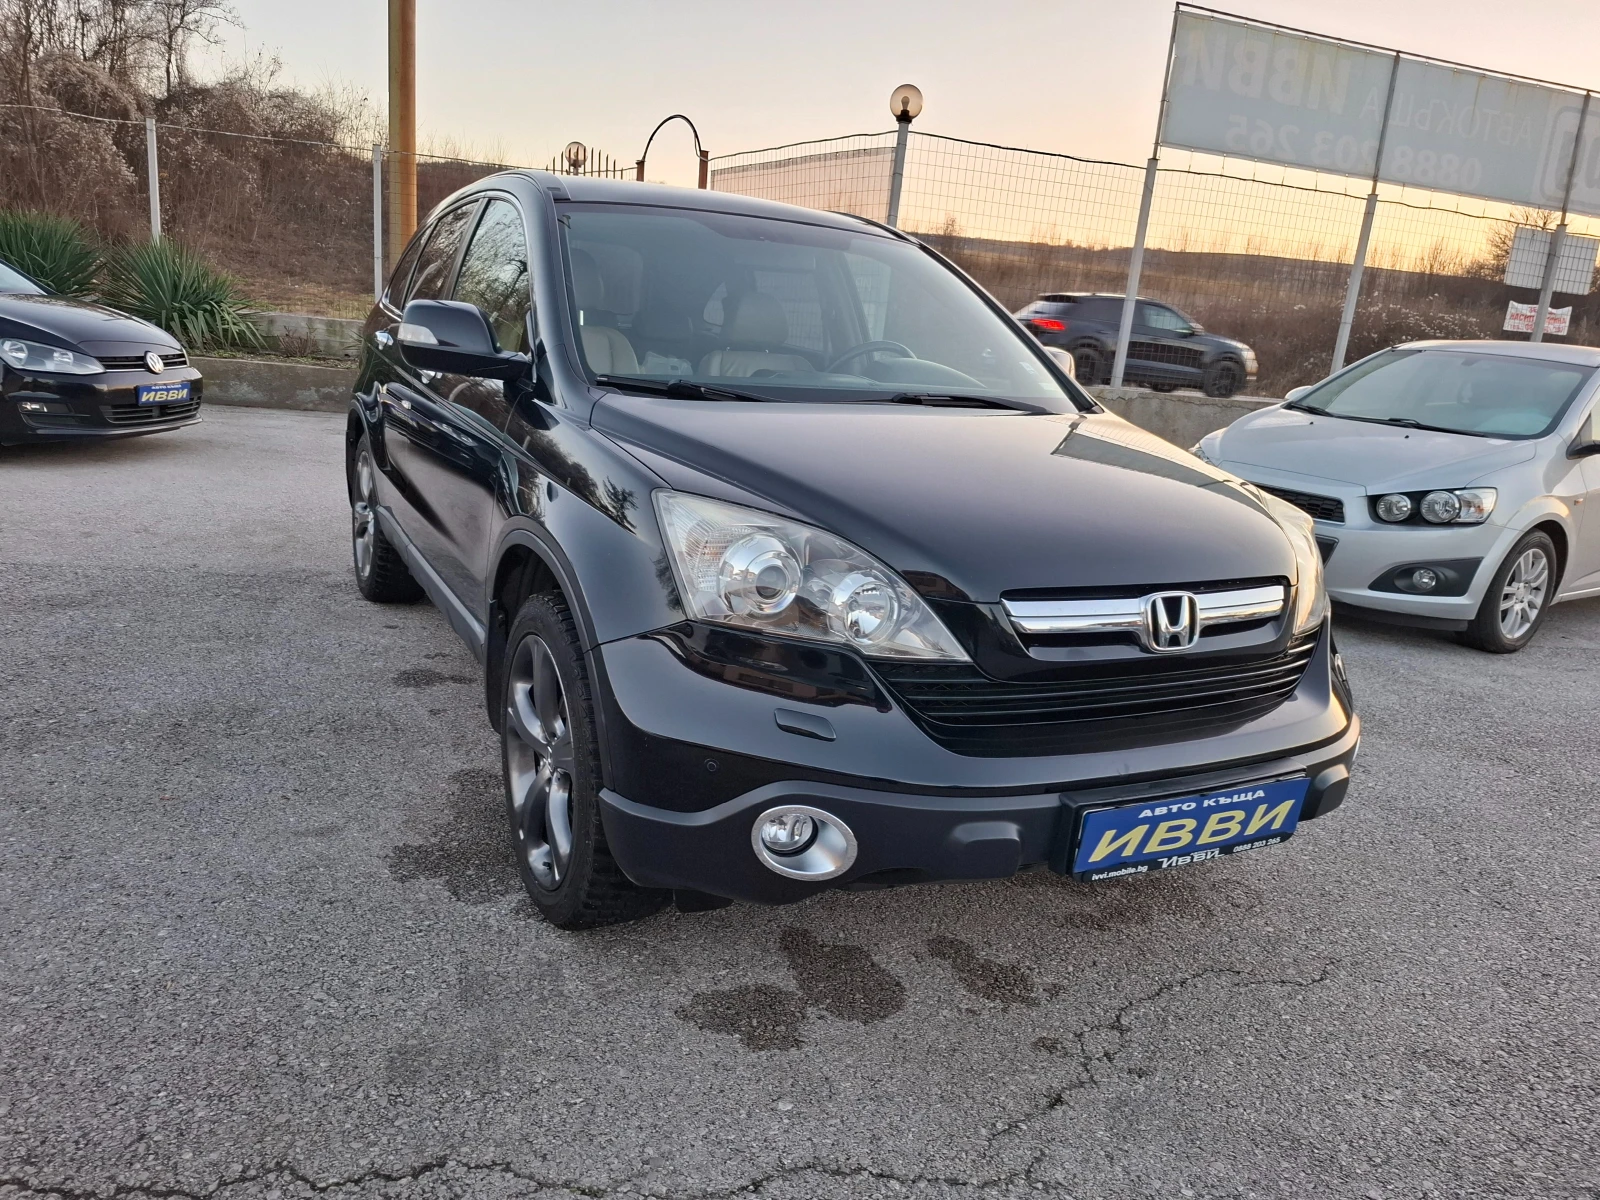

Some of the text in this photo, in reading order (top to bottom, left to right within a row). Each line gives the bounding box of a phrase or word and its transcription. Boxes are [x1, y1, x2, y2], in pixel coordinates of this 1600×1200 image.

[141, 389, 188, 402] ИВВИ
[1138, 789, 1265, 818] АВТО КЪЩА
[1087, 799, 1296, 863] ИВВИ
[1092, 864, 1149, 881] ivvi.mobile.bg
